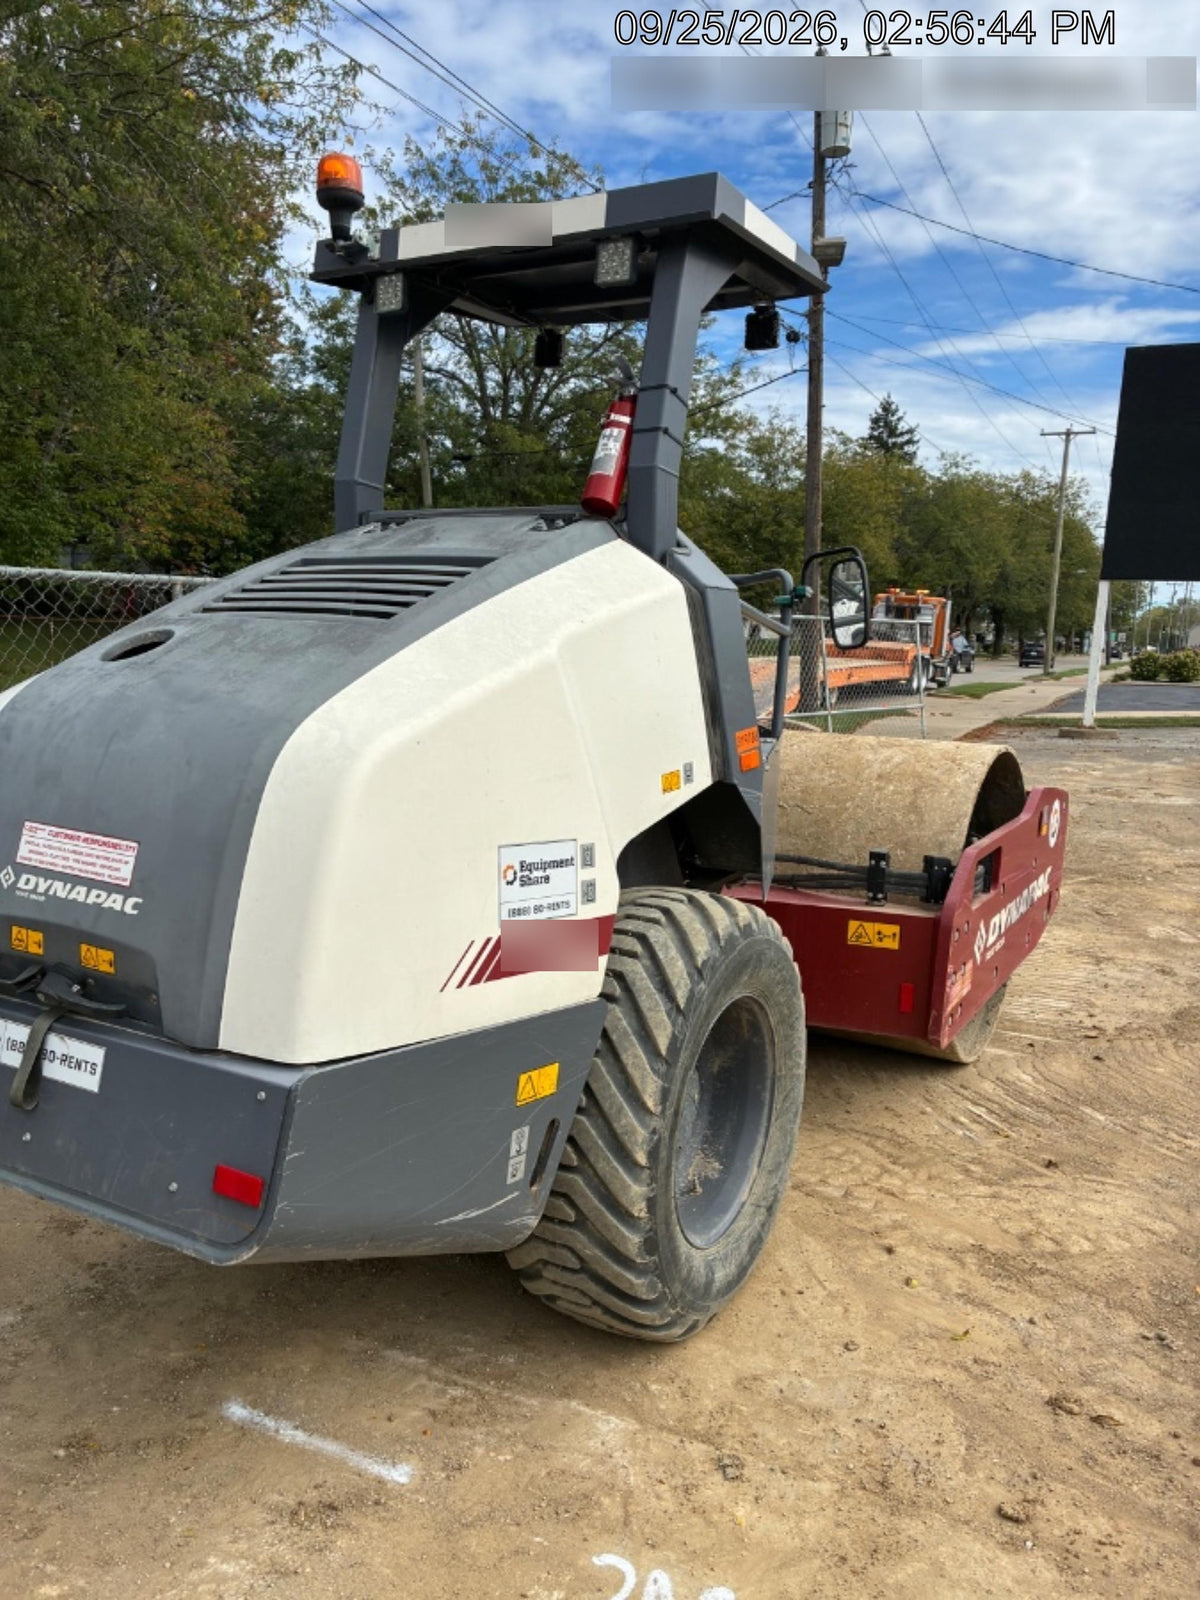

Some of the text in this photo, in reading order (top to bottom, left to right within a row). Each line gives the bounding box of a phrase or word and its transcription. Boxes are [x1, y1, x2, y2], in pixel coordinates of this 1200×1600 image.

[519, 856, 575, 874] Equipment
[16, 873, 143, 915] DYNAPAC
[519, 874, 550, 887] Share
[987, 866, 1053, 949] DYNAPAC
